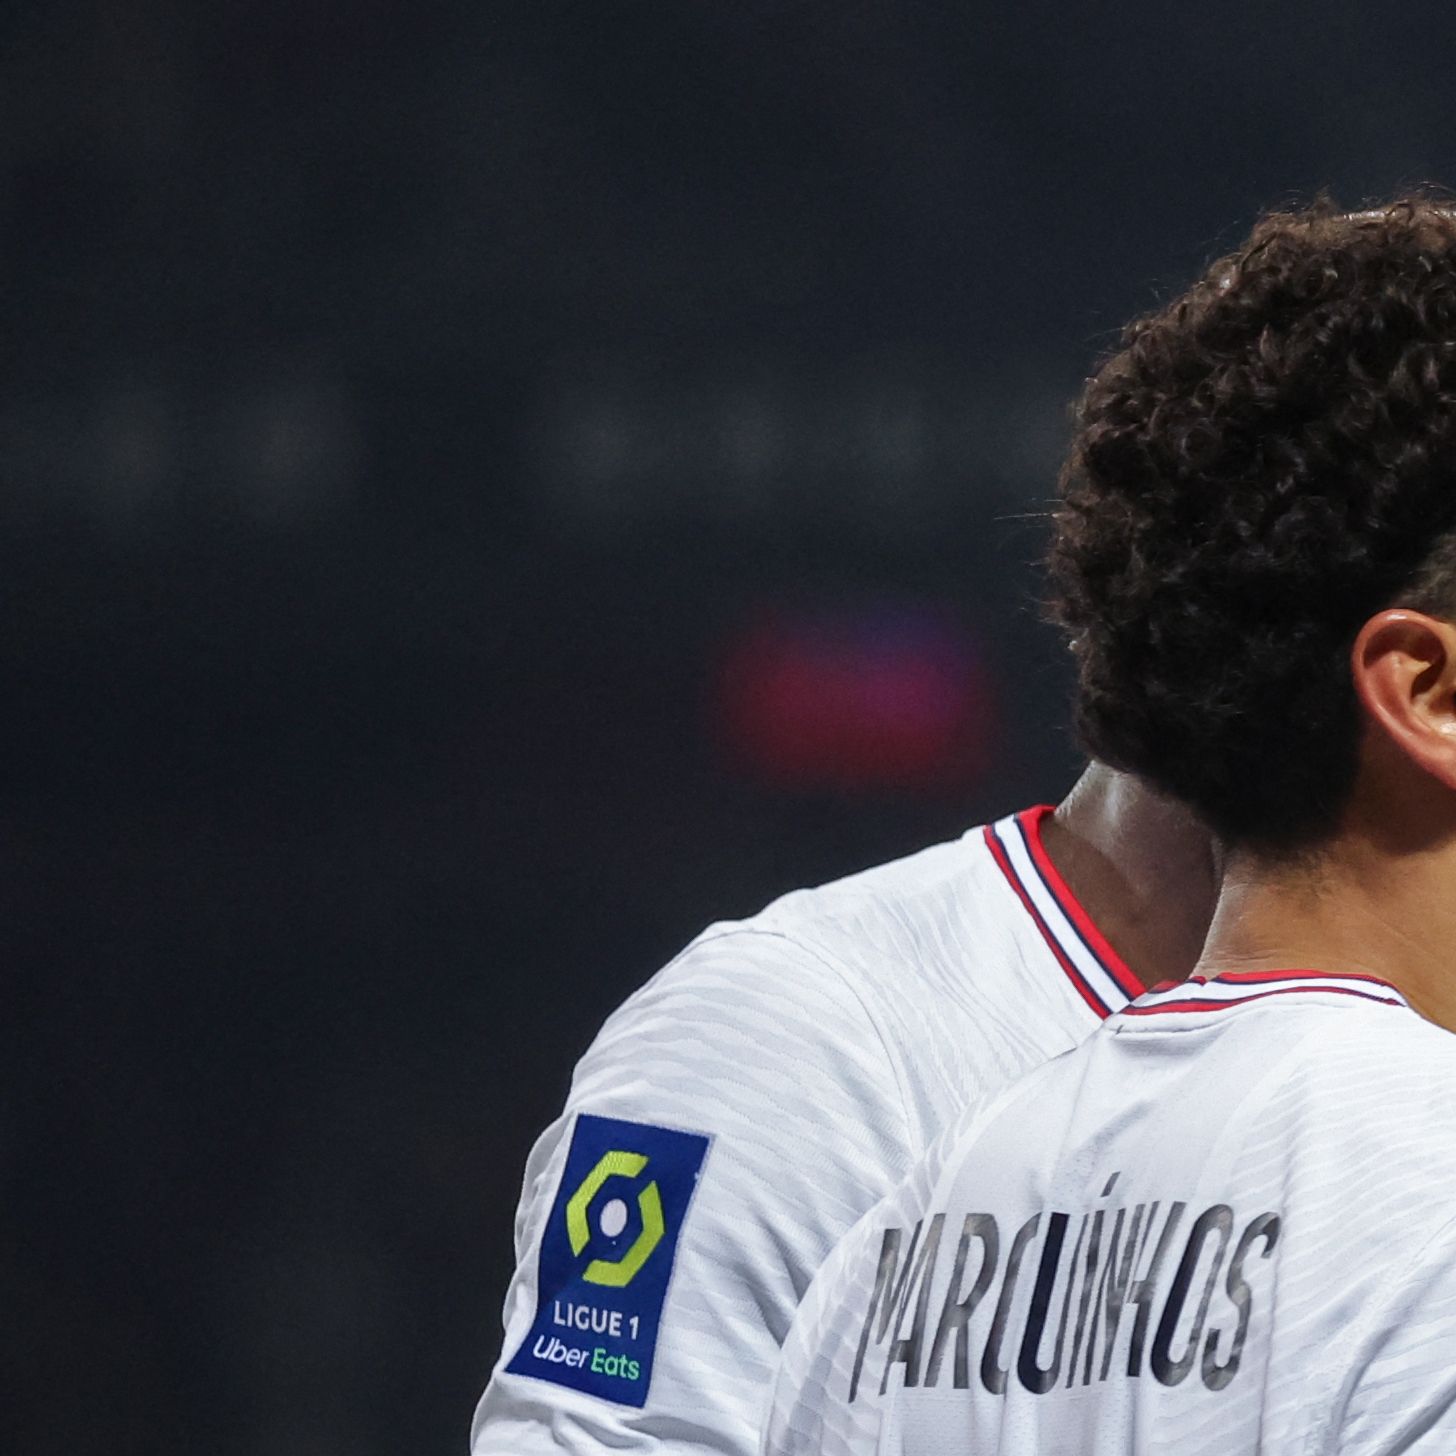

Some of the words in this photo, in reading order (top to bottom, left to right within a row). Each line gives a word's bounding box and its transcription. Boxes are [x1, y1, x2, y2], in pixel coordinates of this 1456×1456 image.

[553, 1300, 623, 1337] LIGUE
[629, 1315, 640, 1340] 1
[532, 1334, 590, 1368] Uber
[590, 1347, 640, 1380] Eats
